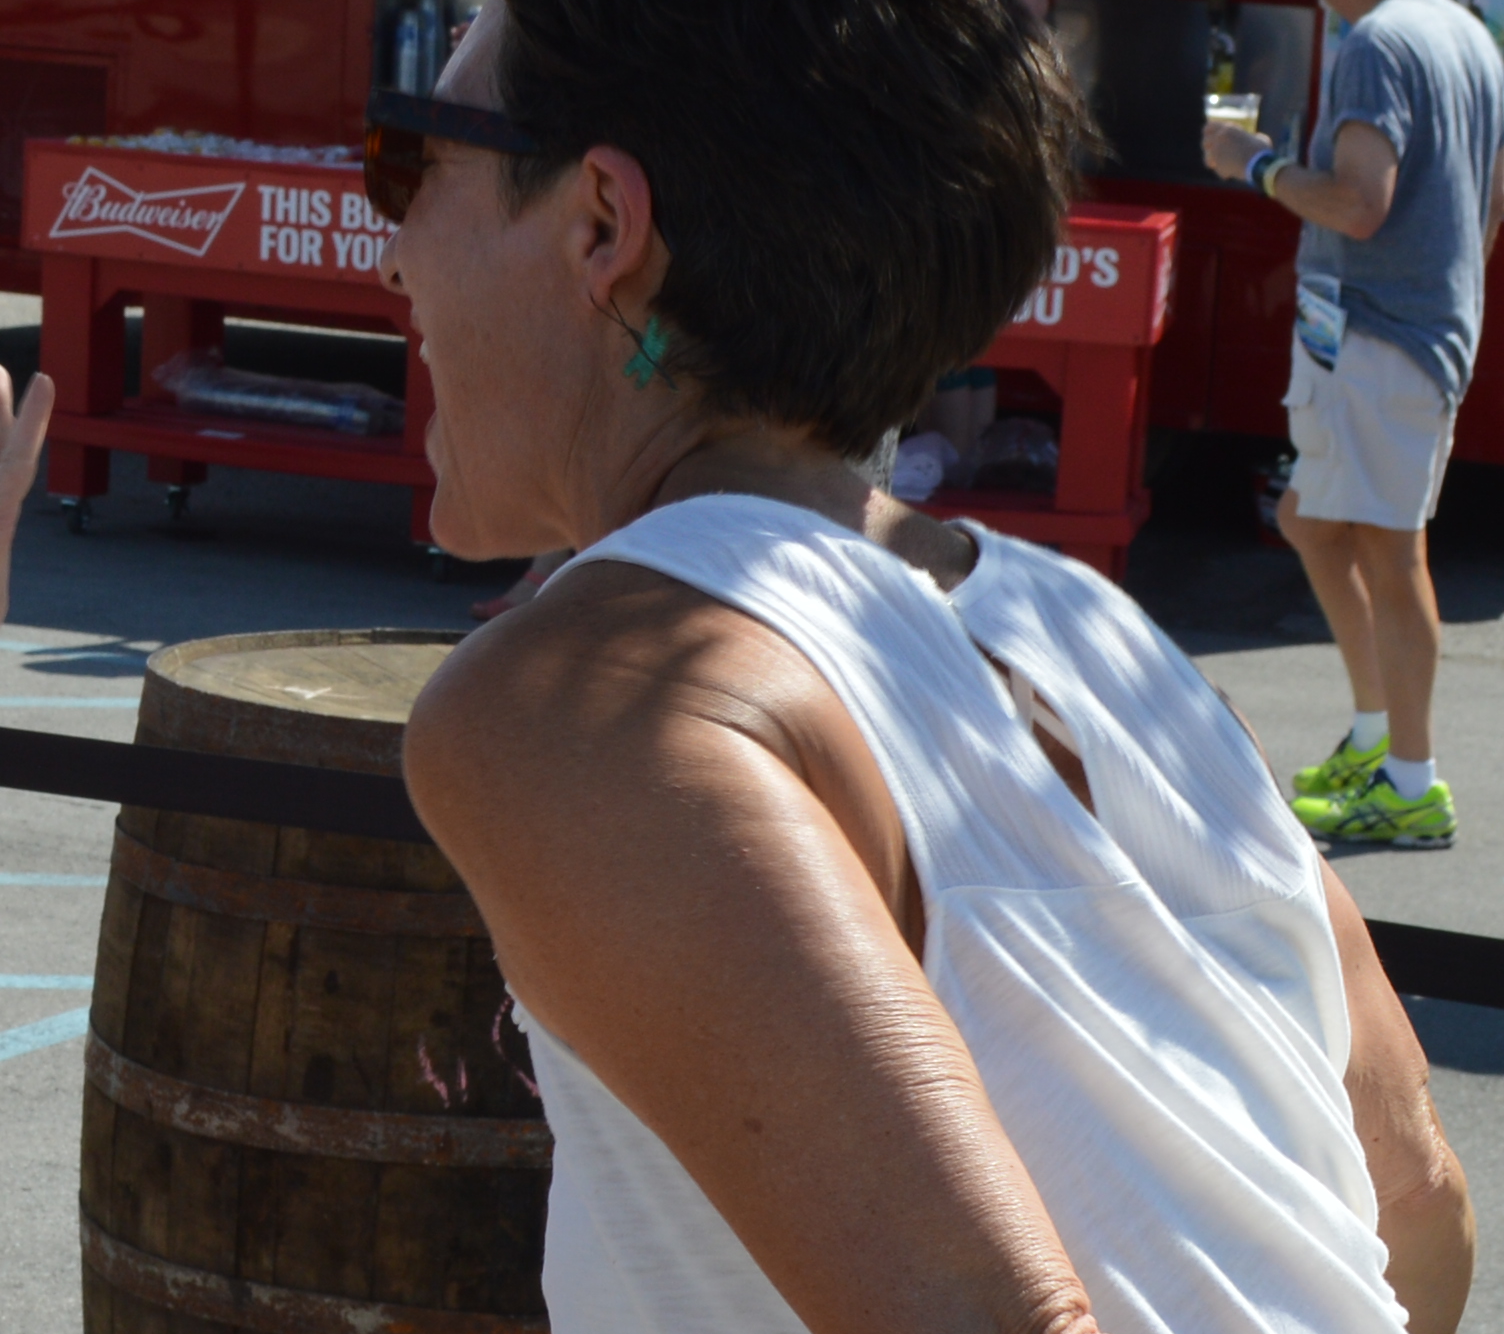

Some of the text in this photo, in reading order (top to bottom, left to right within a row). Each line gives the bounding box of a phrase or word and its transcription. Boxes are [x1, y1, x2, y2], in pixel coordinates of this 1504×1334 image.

[63, 182, 226, 231] Budweiser
[258, 184, 333, 227] THIS
[260, 225, 324, 267] FOR
